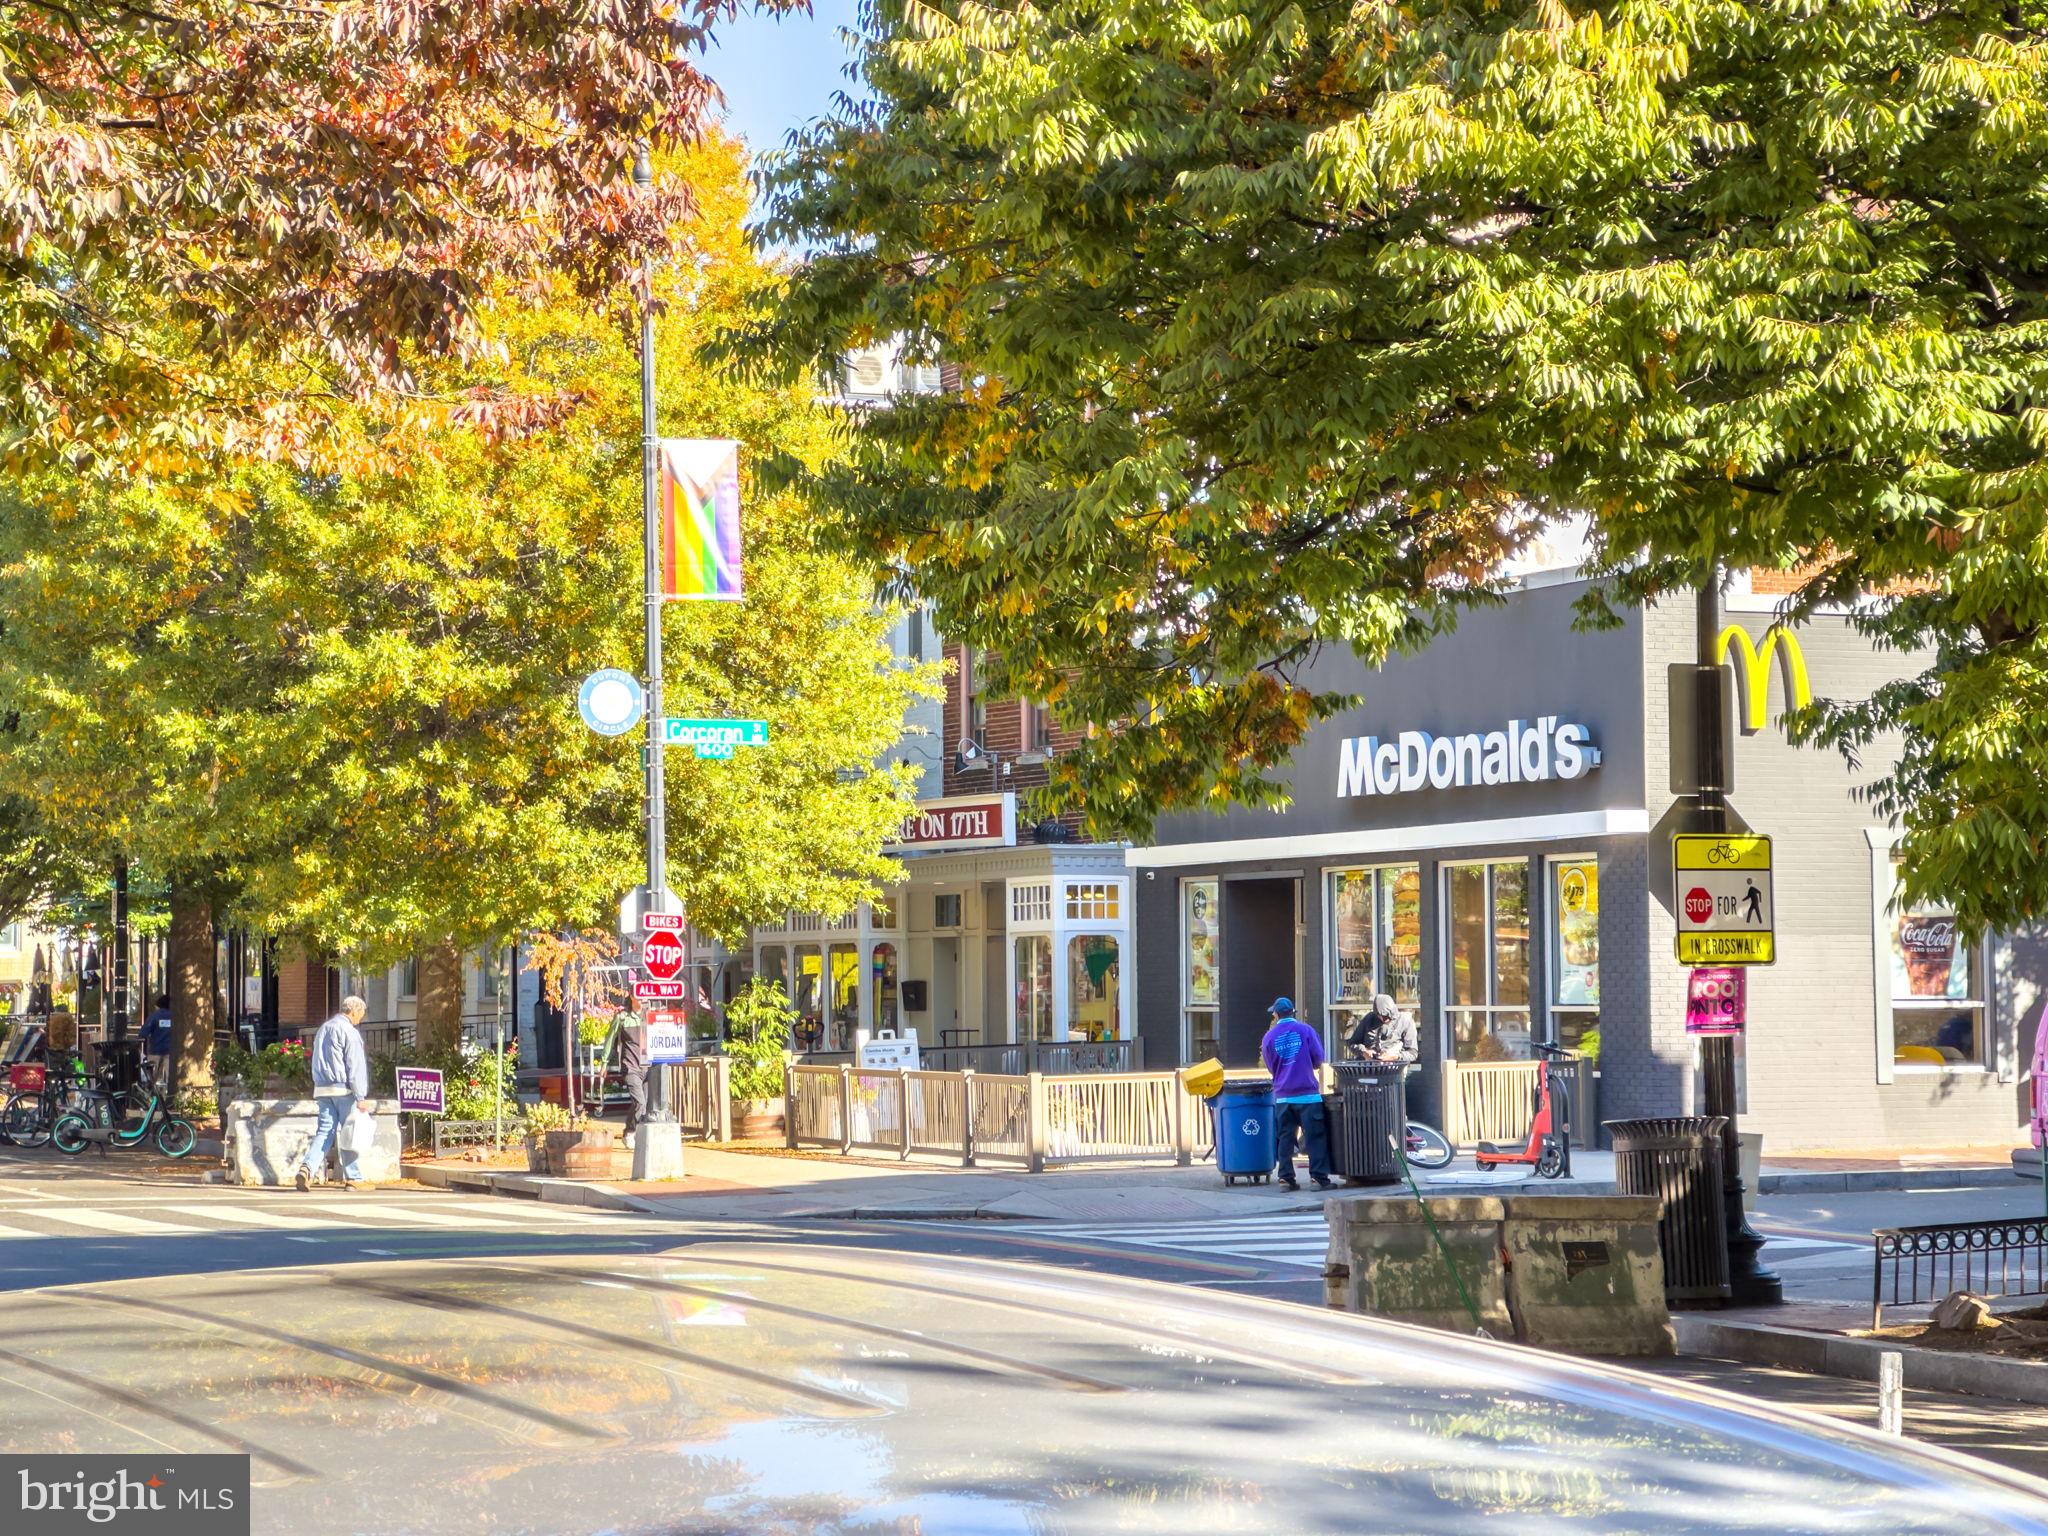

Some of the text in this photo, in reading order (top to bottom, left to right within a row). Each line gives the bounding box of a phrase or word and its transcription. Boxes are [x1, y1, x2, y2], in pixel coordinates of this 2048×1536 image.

[591, 672, 632, 685] DUPONT
[592, 719, 629, 732] CIRCLE
[669, 721, 743, 743] Corcoran
[697, 744, 733, 756] 1600
[1337, 715, 1592, 798] McDonald's
[919, 813, 945, 838] ON
[951, 810, 989, 837] 17TH
[1686, 896, 1738, 916] STOP FOR
[648, 916, 679, 928] BIKES
[1901, 922, 1955, 946] Coca-Cola
[1691, 938, 1762, 955] IN CROSSWALK
[645, 944, 682, 966] STOP
[639, 984, 679, 996] ALL WAY
[650, 1036, 683, 1049] JORDAN
[400, 1079, 440, 1092] ROBERT
[403, 1089, 437, 1101] WHITE
[100, 1104, 109, 1126] veo
